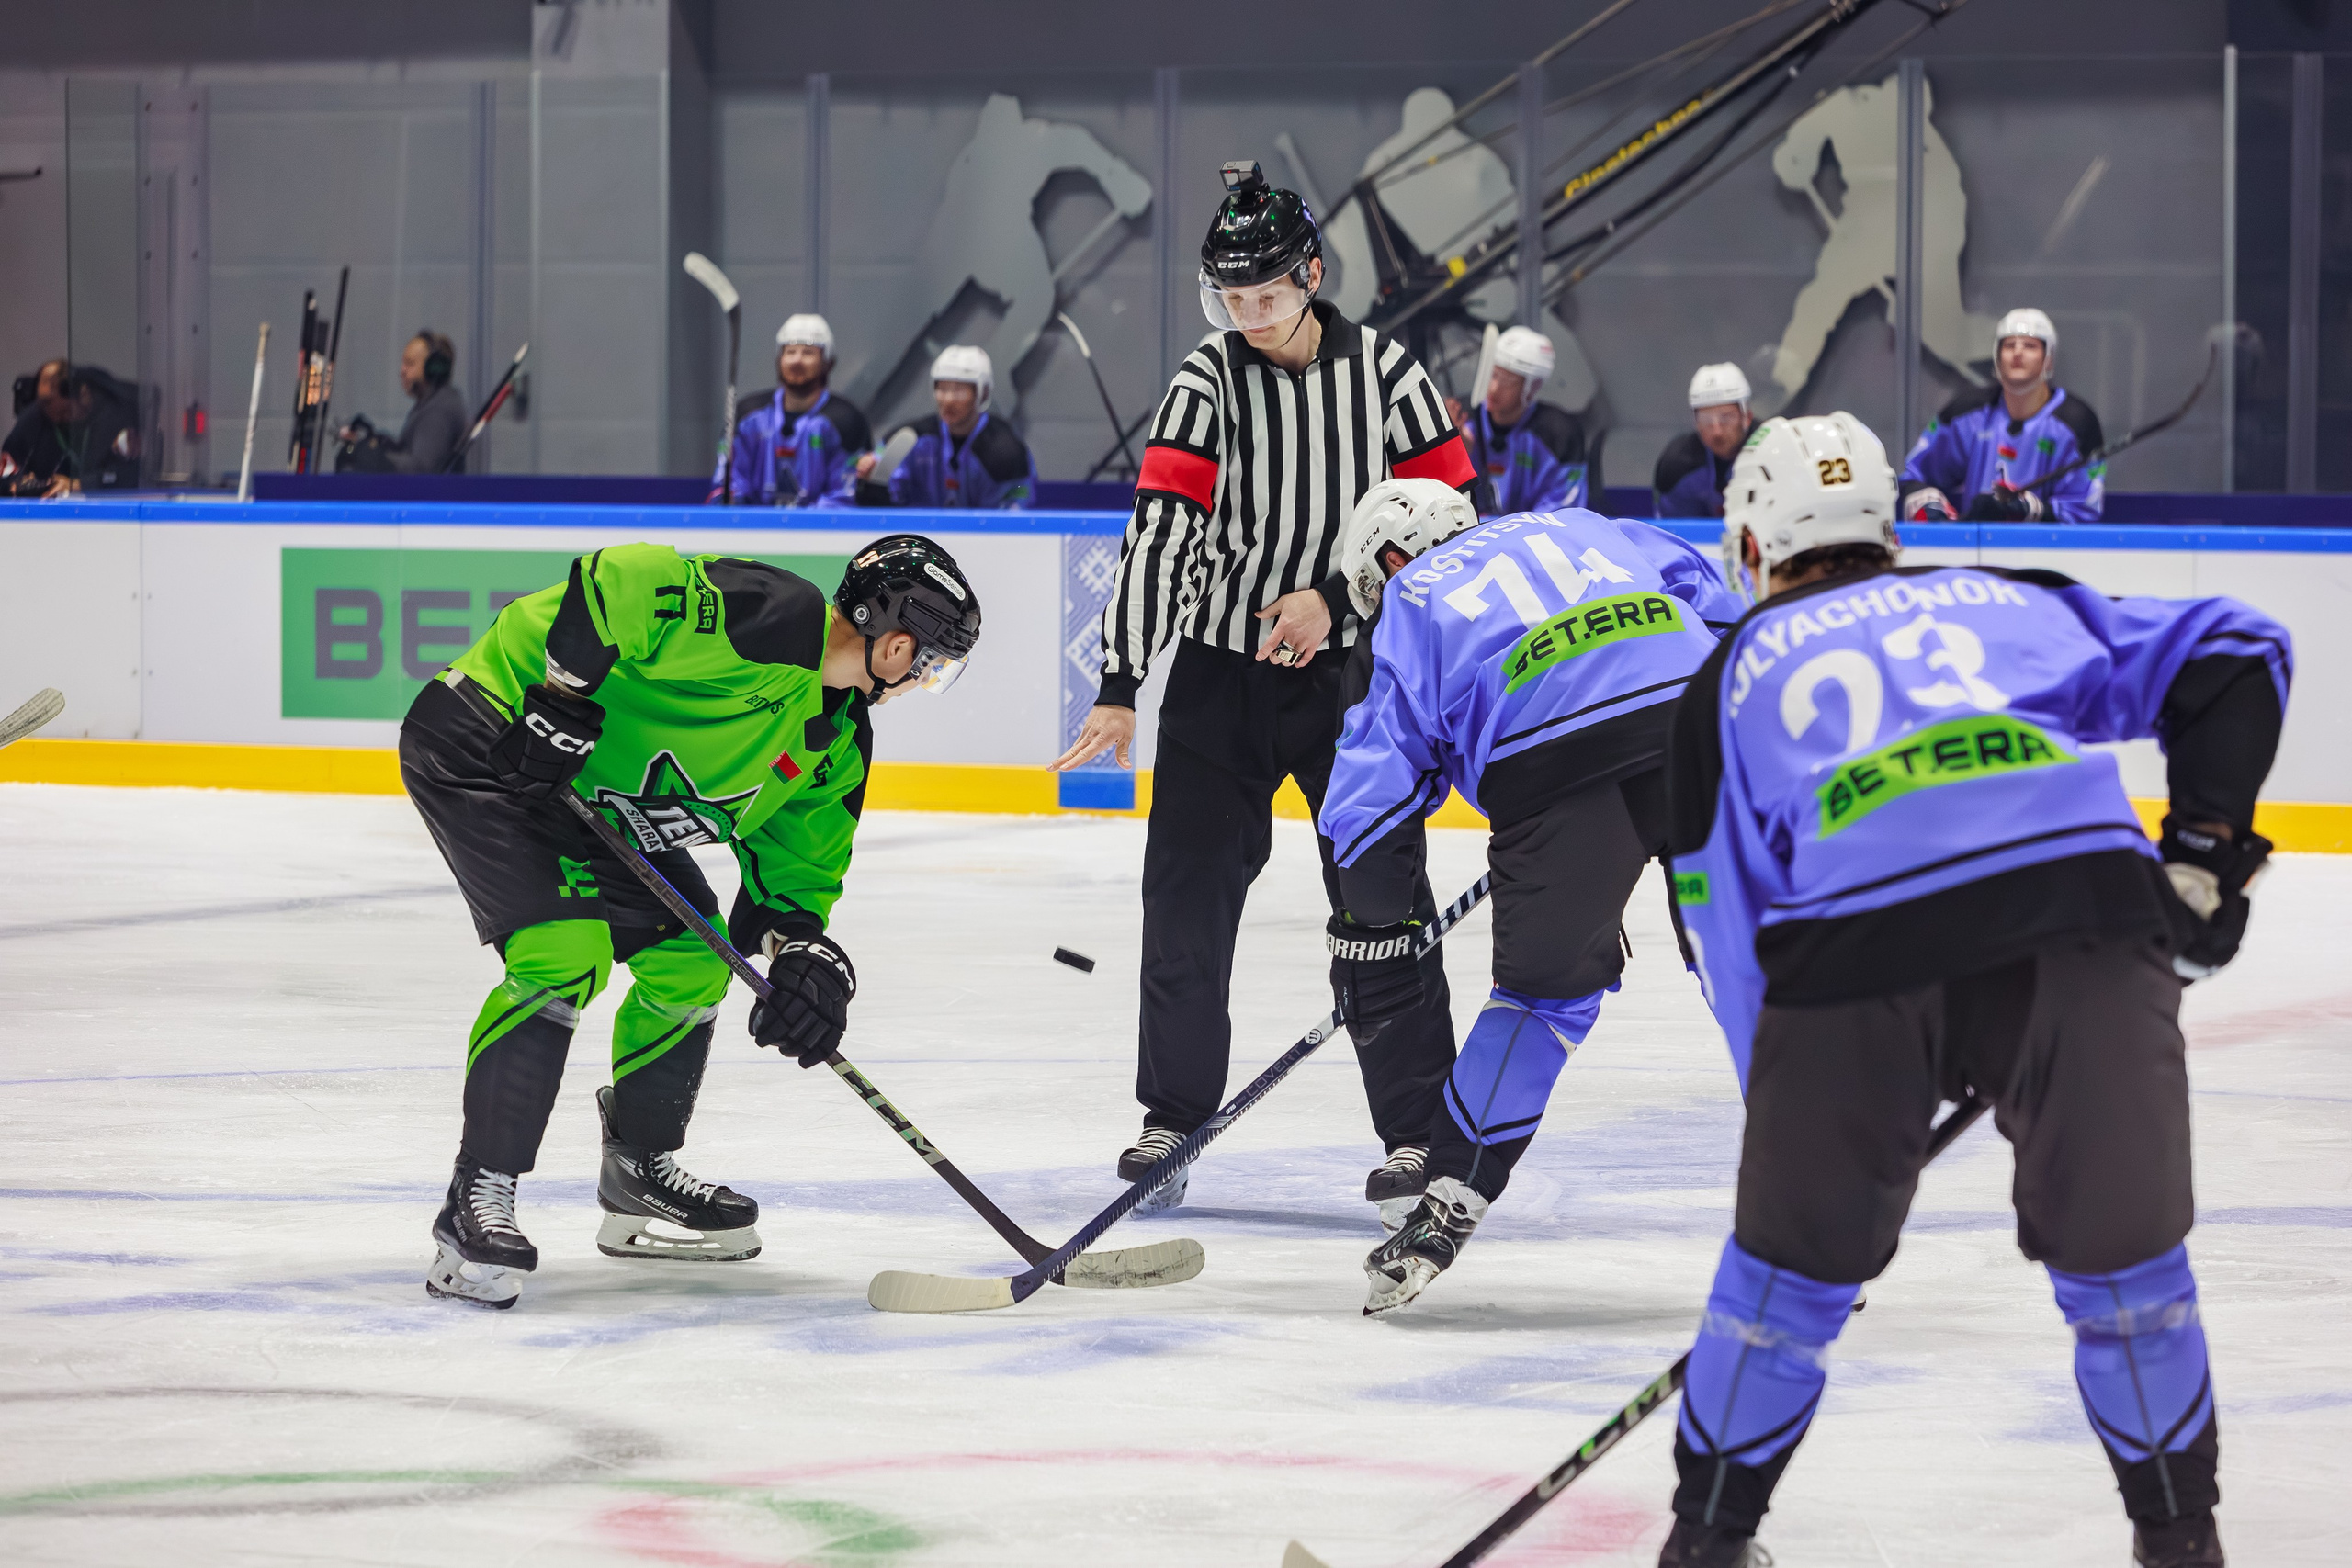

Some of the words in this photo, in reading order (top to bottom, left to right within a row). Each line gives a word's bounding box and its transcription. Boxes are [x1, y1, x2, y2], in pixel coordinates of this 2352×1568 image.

[1217, 260, 1250, 269] CCM
[1818, 457, 1852, 486] 23
[1360, 526, 1380, 554] CCM
[1442, 531, 1635, 631] 74
[1729, 576, 2028, 719] ULYACHONOK
[1779, 613, 2011, 776] 23
[1828, 729, 2054, 820] BETERA
[626, 808, 667, 852] SHARA
[778, 941, 854, 991] CCM
[1326, 933, 1410, 961] ARRIOR
[725, 950, 762, 990] TRIGGER
[1246, 1046, 1301, 1097] COVERT
[832, 1060, 946, 1165] CCM
[642, 1193, 689, 1221] BAUER
[1392, 1224, 1430, 1258] CCM
